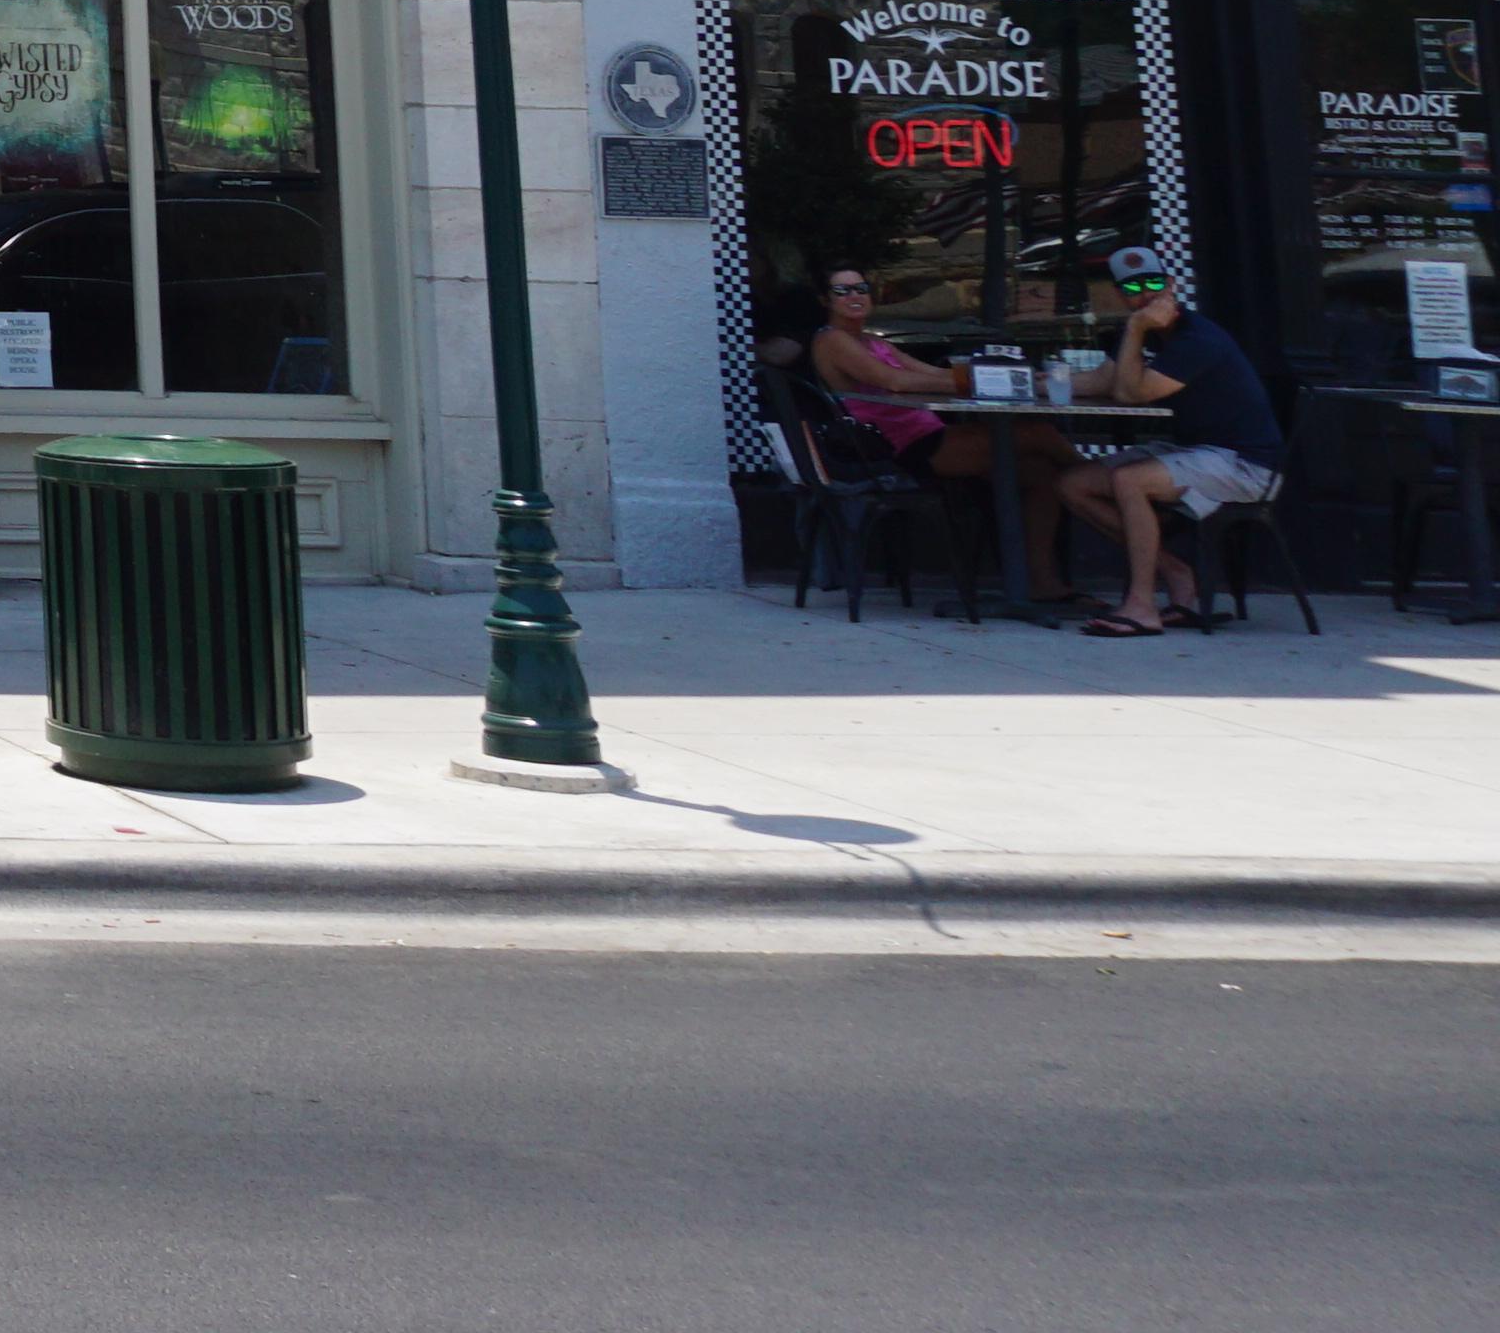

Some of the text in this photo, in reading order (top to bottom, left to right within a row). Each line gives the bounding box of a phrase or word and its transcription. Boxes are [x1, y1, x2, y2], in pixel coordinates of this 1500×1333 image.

[172, 3, 294, 34] WOODS
[840, 0, 1032, 47] Welcome to
[828, 57, 1051, 98] PARADISE
[1319, 91, 1460, 118] PARADISE
[866, 119, 1014, 168] OPEN
